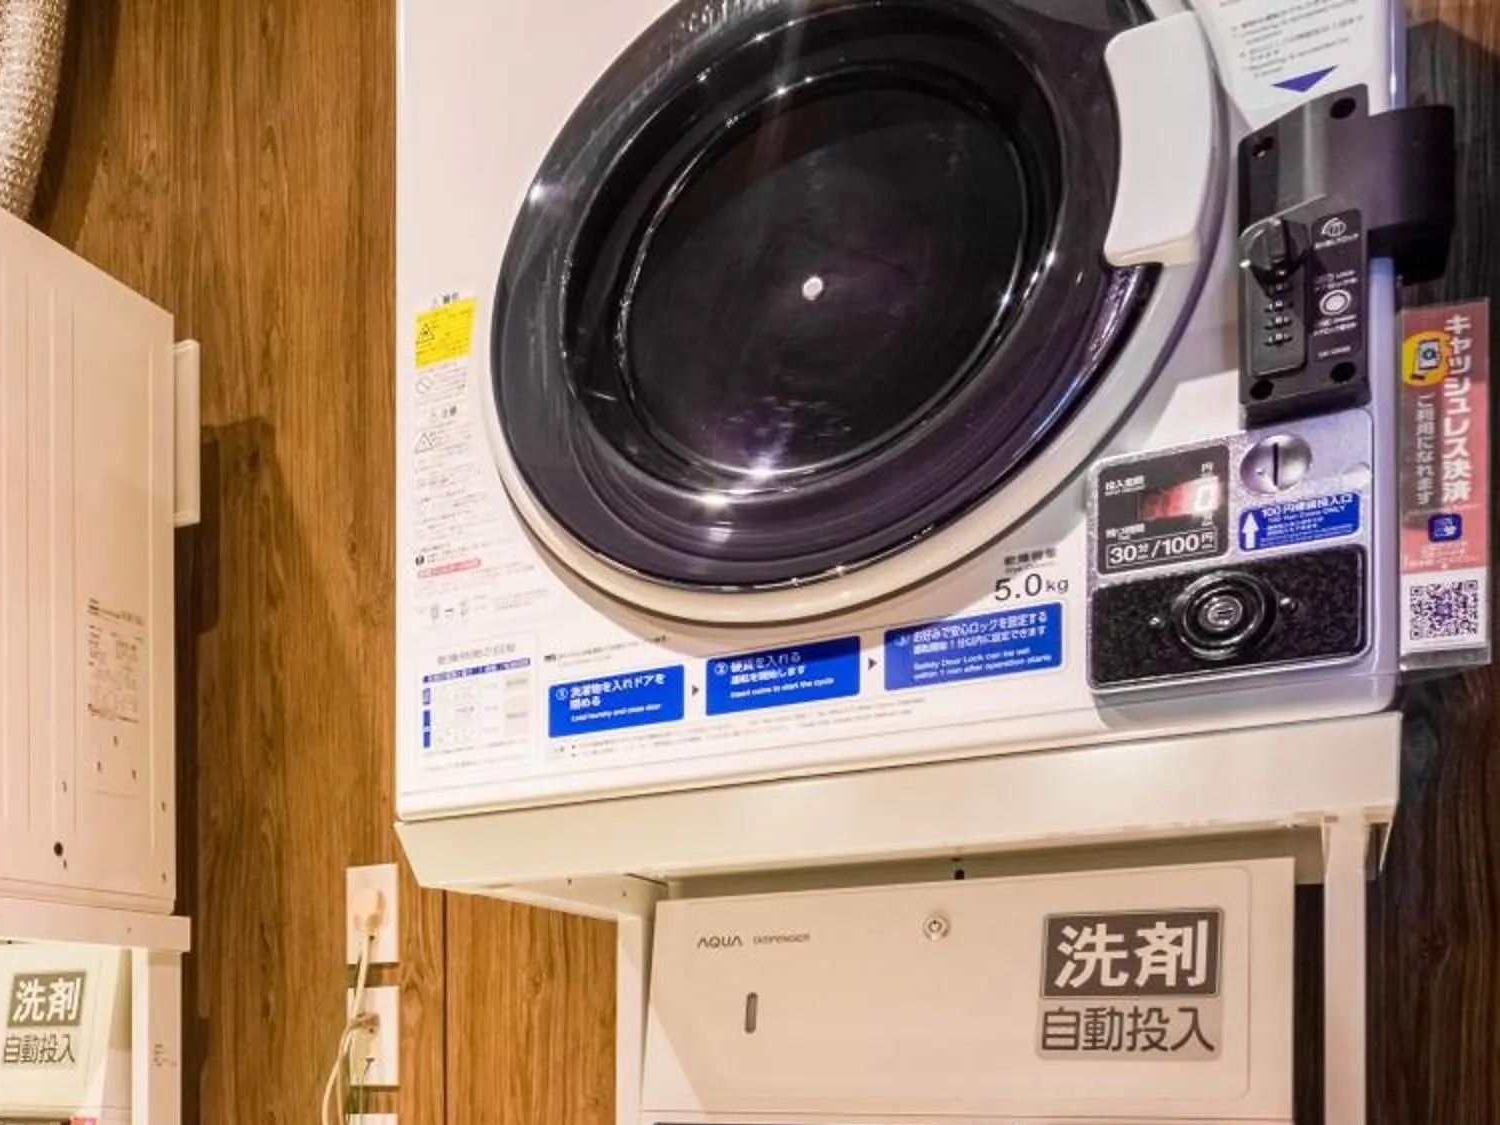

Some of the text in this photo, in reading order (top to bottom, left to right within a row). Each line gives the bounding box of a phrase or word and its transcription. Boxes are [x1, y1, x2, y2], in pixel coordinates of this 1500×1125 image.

[1443, 315, 1472, 502] キャッシュレス決済
[1416, 392, 1437, 505] ご利用になれます
[697, 934, 743, 949] AQUA
[1055, 920, 1207, 989] 洗剤
[12, 977, 82, 1023] 洗剤
[3, 1033, 76, 1064] 自動投入
[1042, 1006, 1215, 1052] 自動投入
